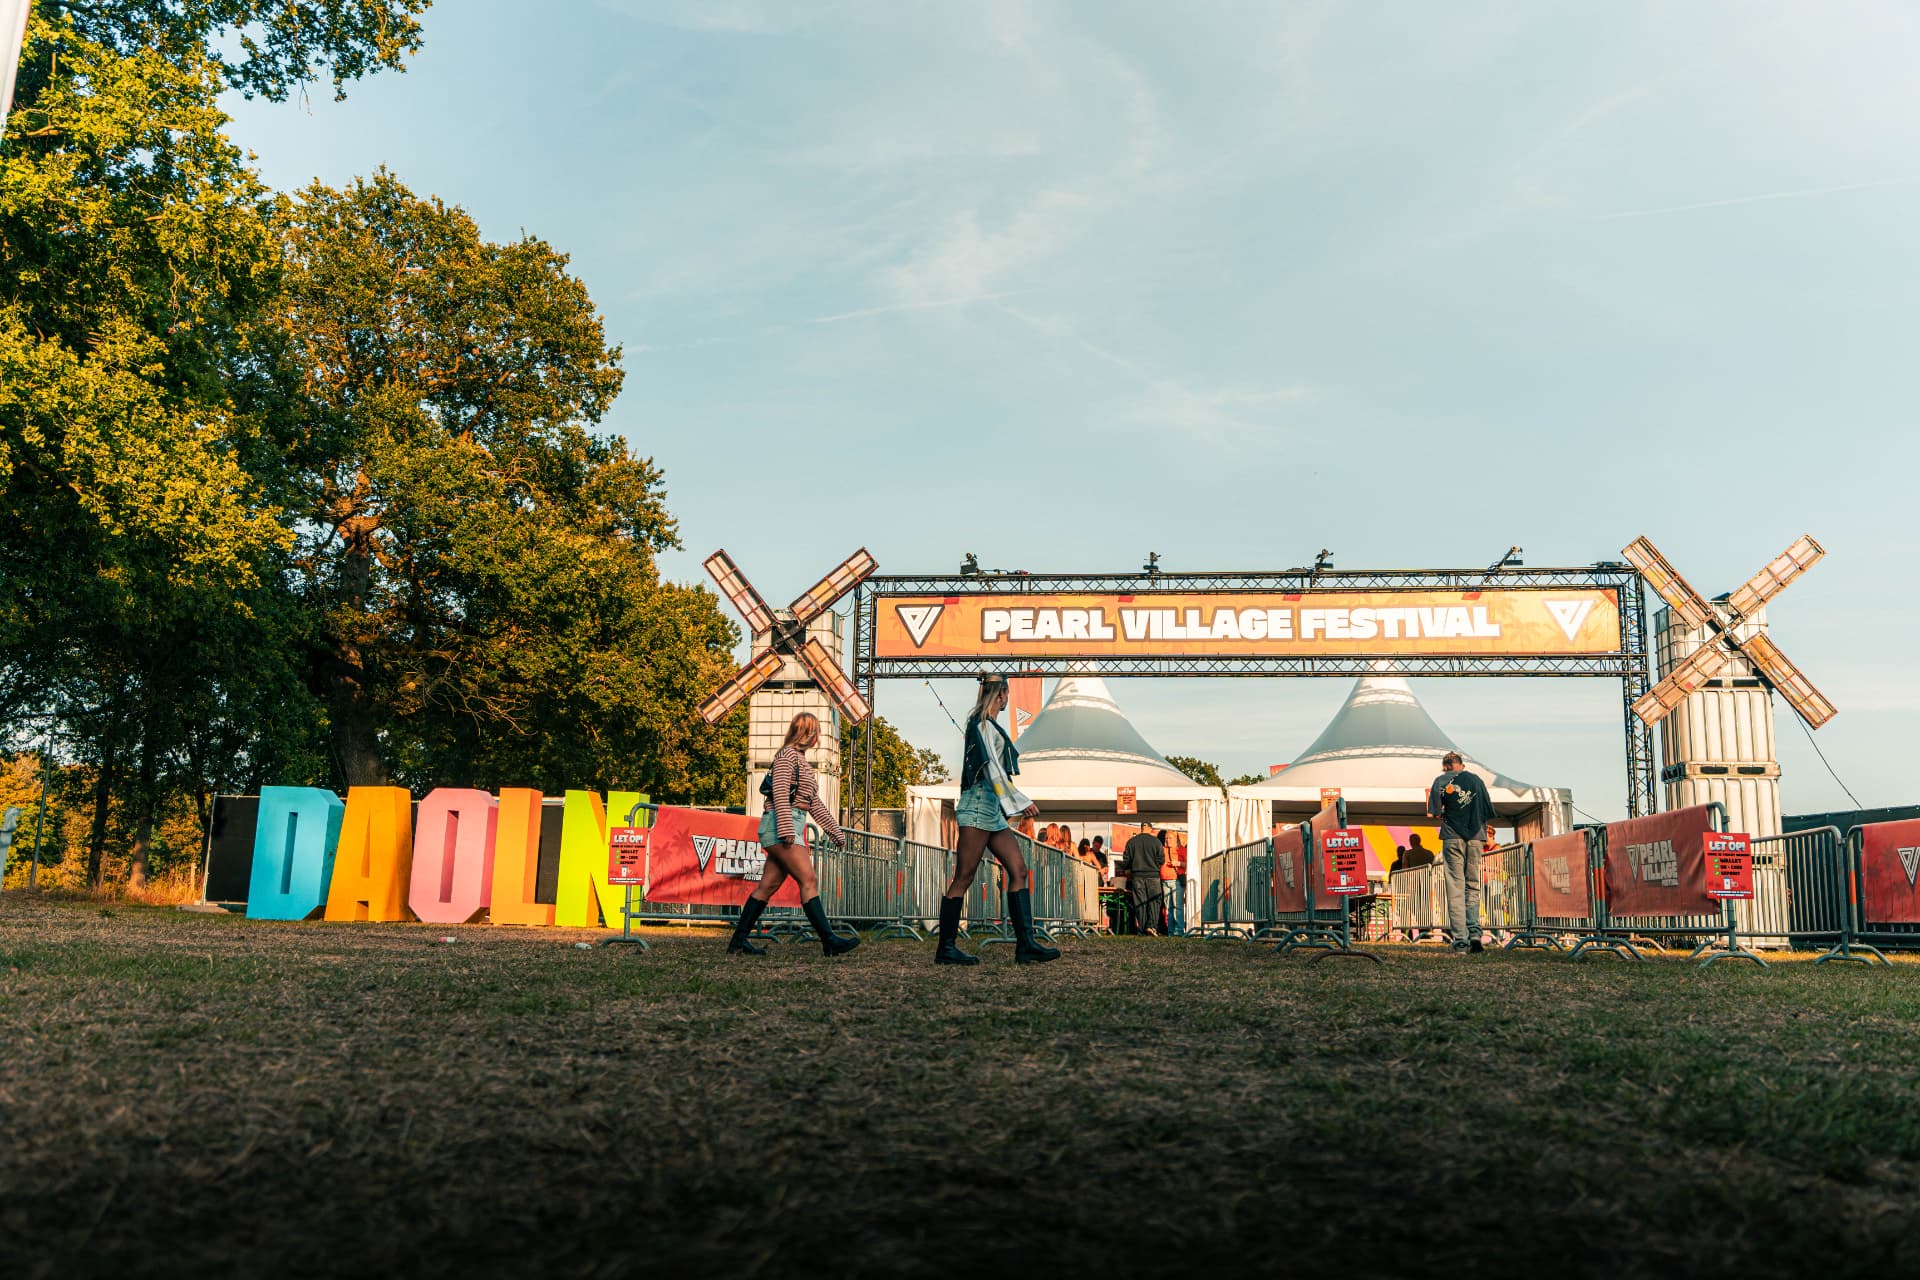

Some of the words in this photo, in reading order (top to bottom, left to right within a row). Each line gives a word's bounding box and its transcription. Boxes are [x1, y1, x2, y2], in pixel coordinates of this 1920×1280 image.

[983, 607, 1116, 641] PEARL
[1120, 607, 1294, 640] VILLAGE
[1300, 605, 1501, 639] FESTIVAL
[614, 834, 629, 843] LET
[1326, 837, 1343, 848] LET
[1708, 841, 1727, 851] LET
[715, 838, 768, 861] PEARL
[1639, 839, 1677, 864] PEARL
[1641, 861, 1678, 881] VILLAGE
